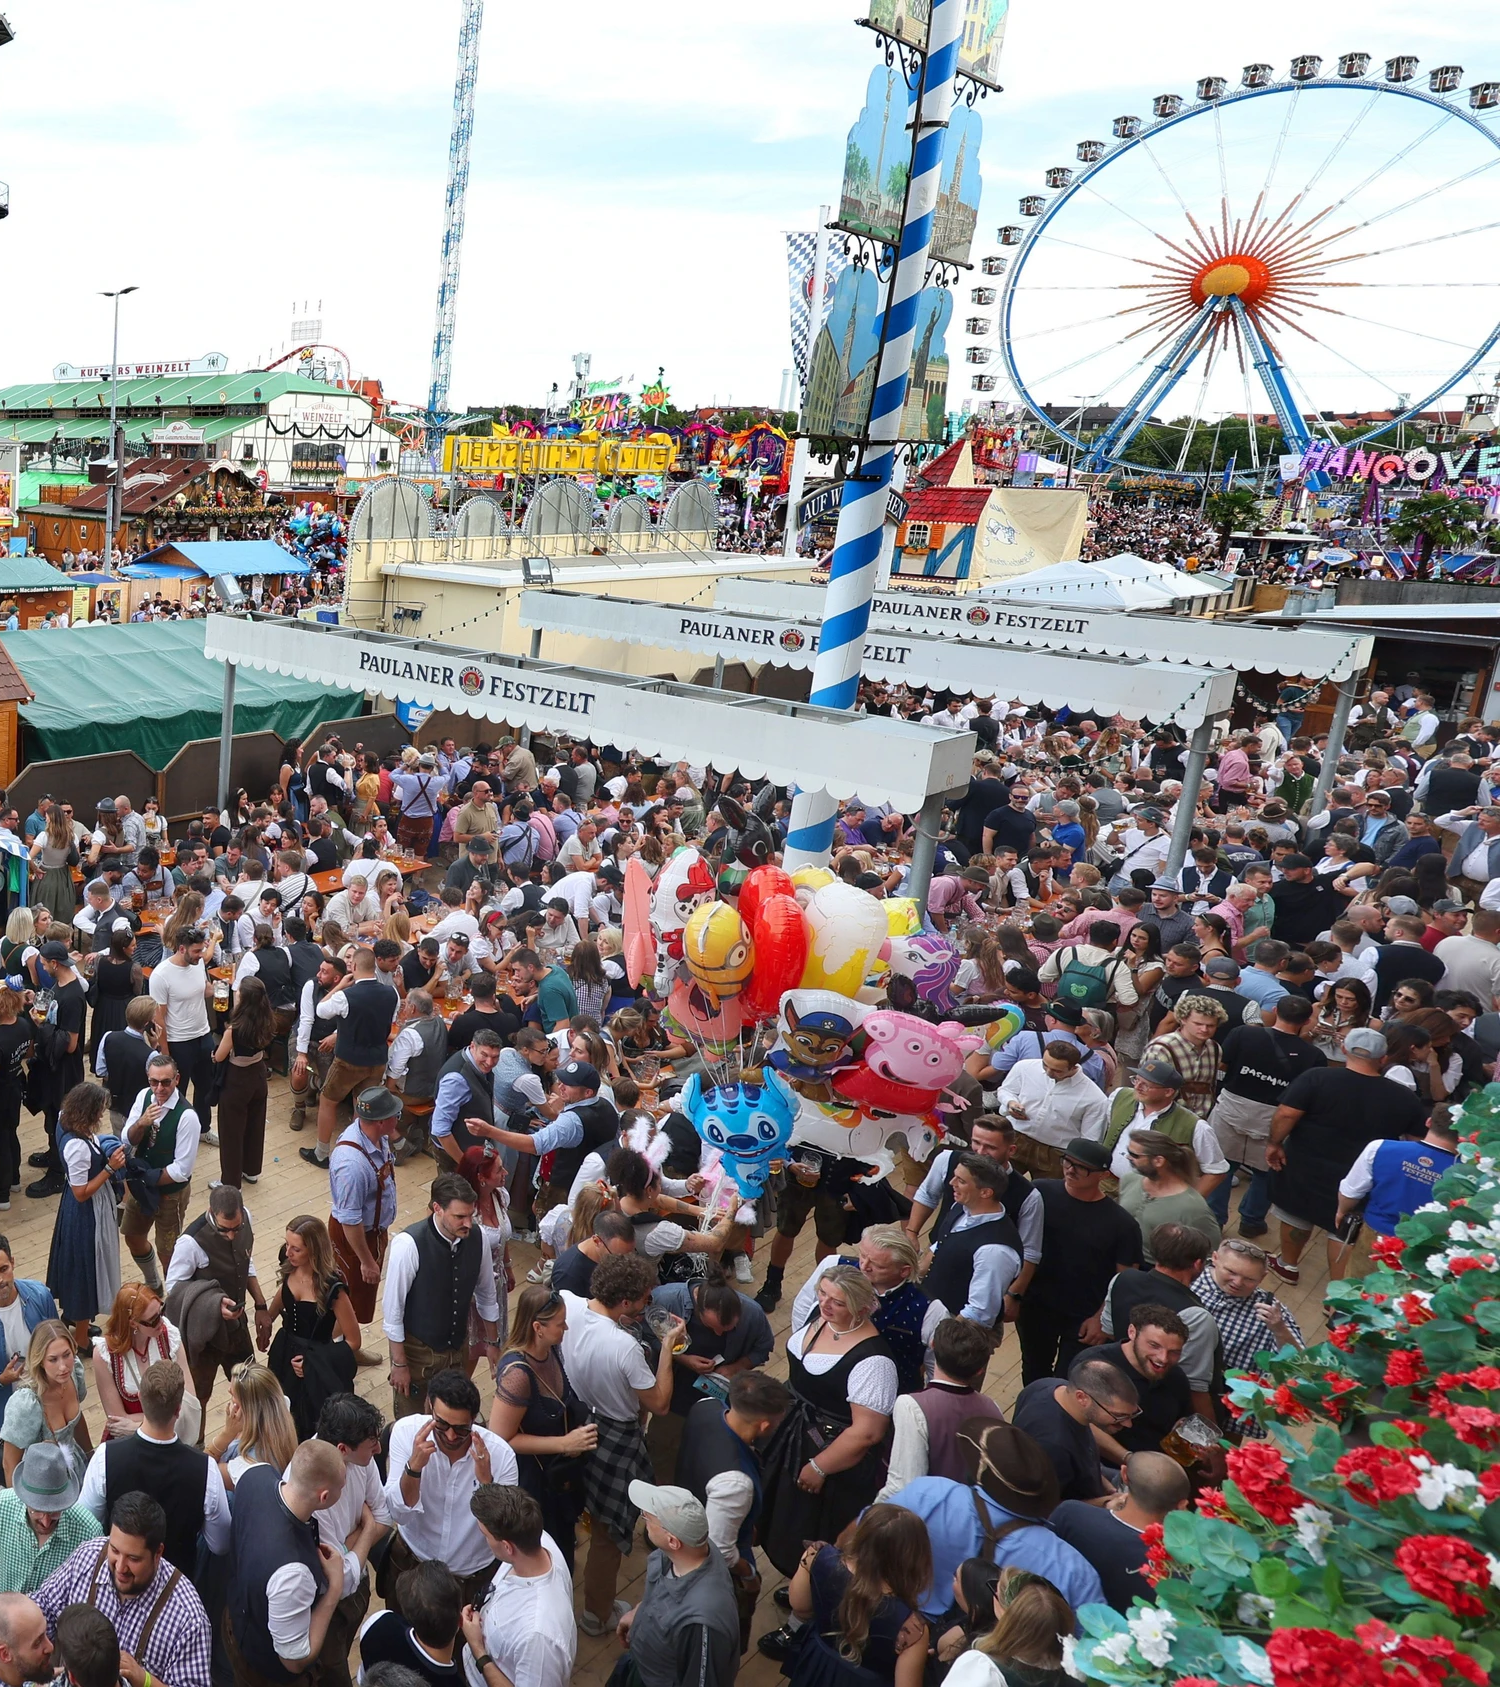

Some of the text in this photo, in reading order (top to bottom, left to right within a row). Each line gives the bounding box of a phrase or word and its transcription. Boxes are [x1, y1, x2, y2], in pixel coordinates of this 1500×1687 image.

[135, 362, 191, 375] WEINZELT
[302, 411, 343, 423] WEINZELT
[569, 391, 632, 419] BREAK
[581, 406, 640, 432] DANCE
[803, 491, 828, 523] AUF
[19, 585, 49, 593] Macadamia
[872, 598, 1089, 635] PAULANER FESTZELT
[679, 618, 911, 665] PAULANER FZELT
[359, 651, 597, 715] PAULANER FESTZELT
[1402, 1160, 1443, 1180] PAULANER
